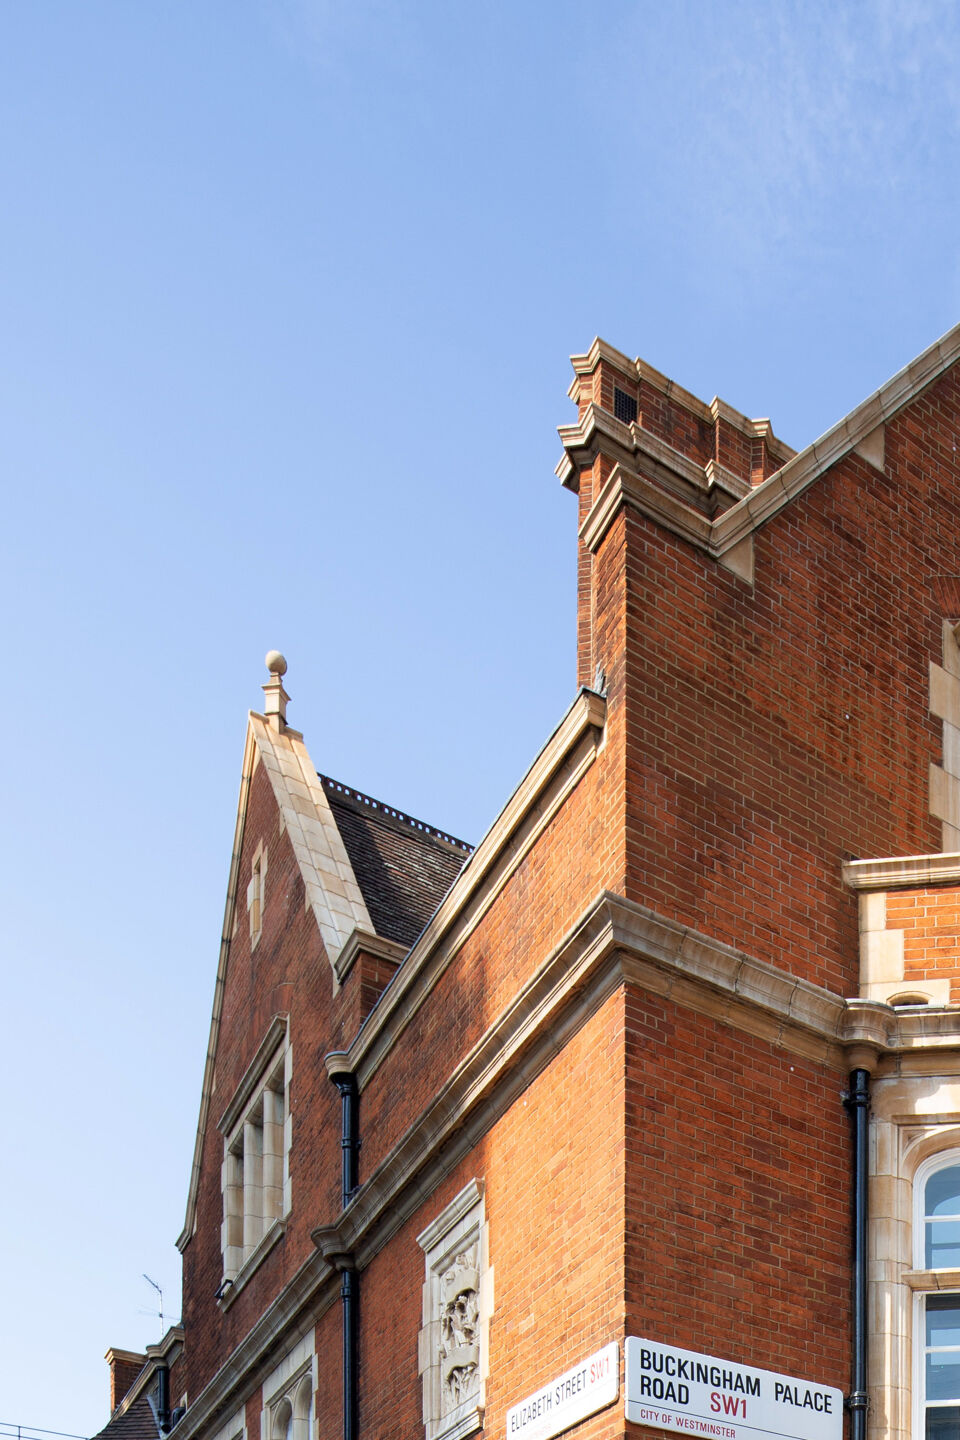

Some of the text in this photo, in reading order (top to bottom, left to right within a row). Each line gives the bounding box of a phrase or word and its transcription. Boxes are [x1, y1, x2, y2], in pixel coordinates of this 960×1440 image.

[511, 1355, 610, 1433] ELIZABETH STREET SW1
[640, 1348, 833, 1414] BUCKINGHAM PALACE
[640, 1374, 748, 1419] ROAD SW1
[640, 1408, 736, 1439] CITY OF WESTMINSTER
